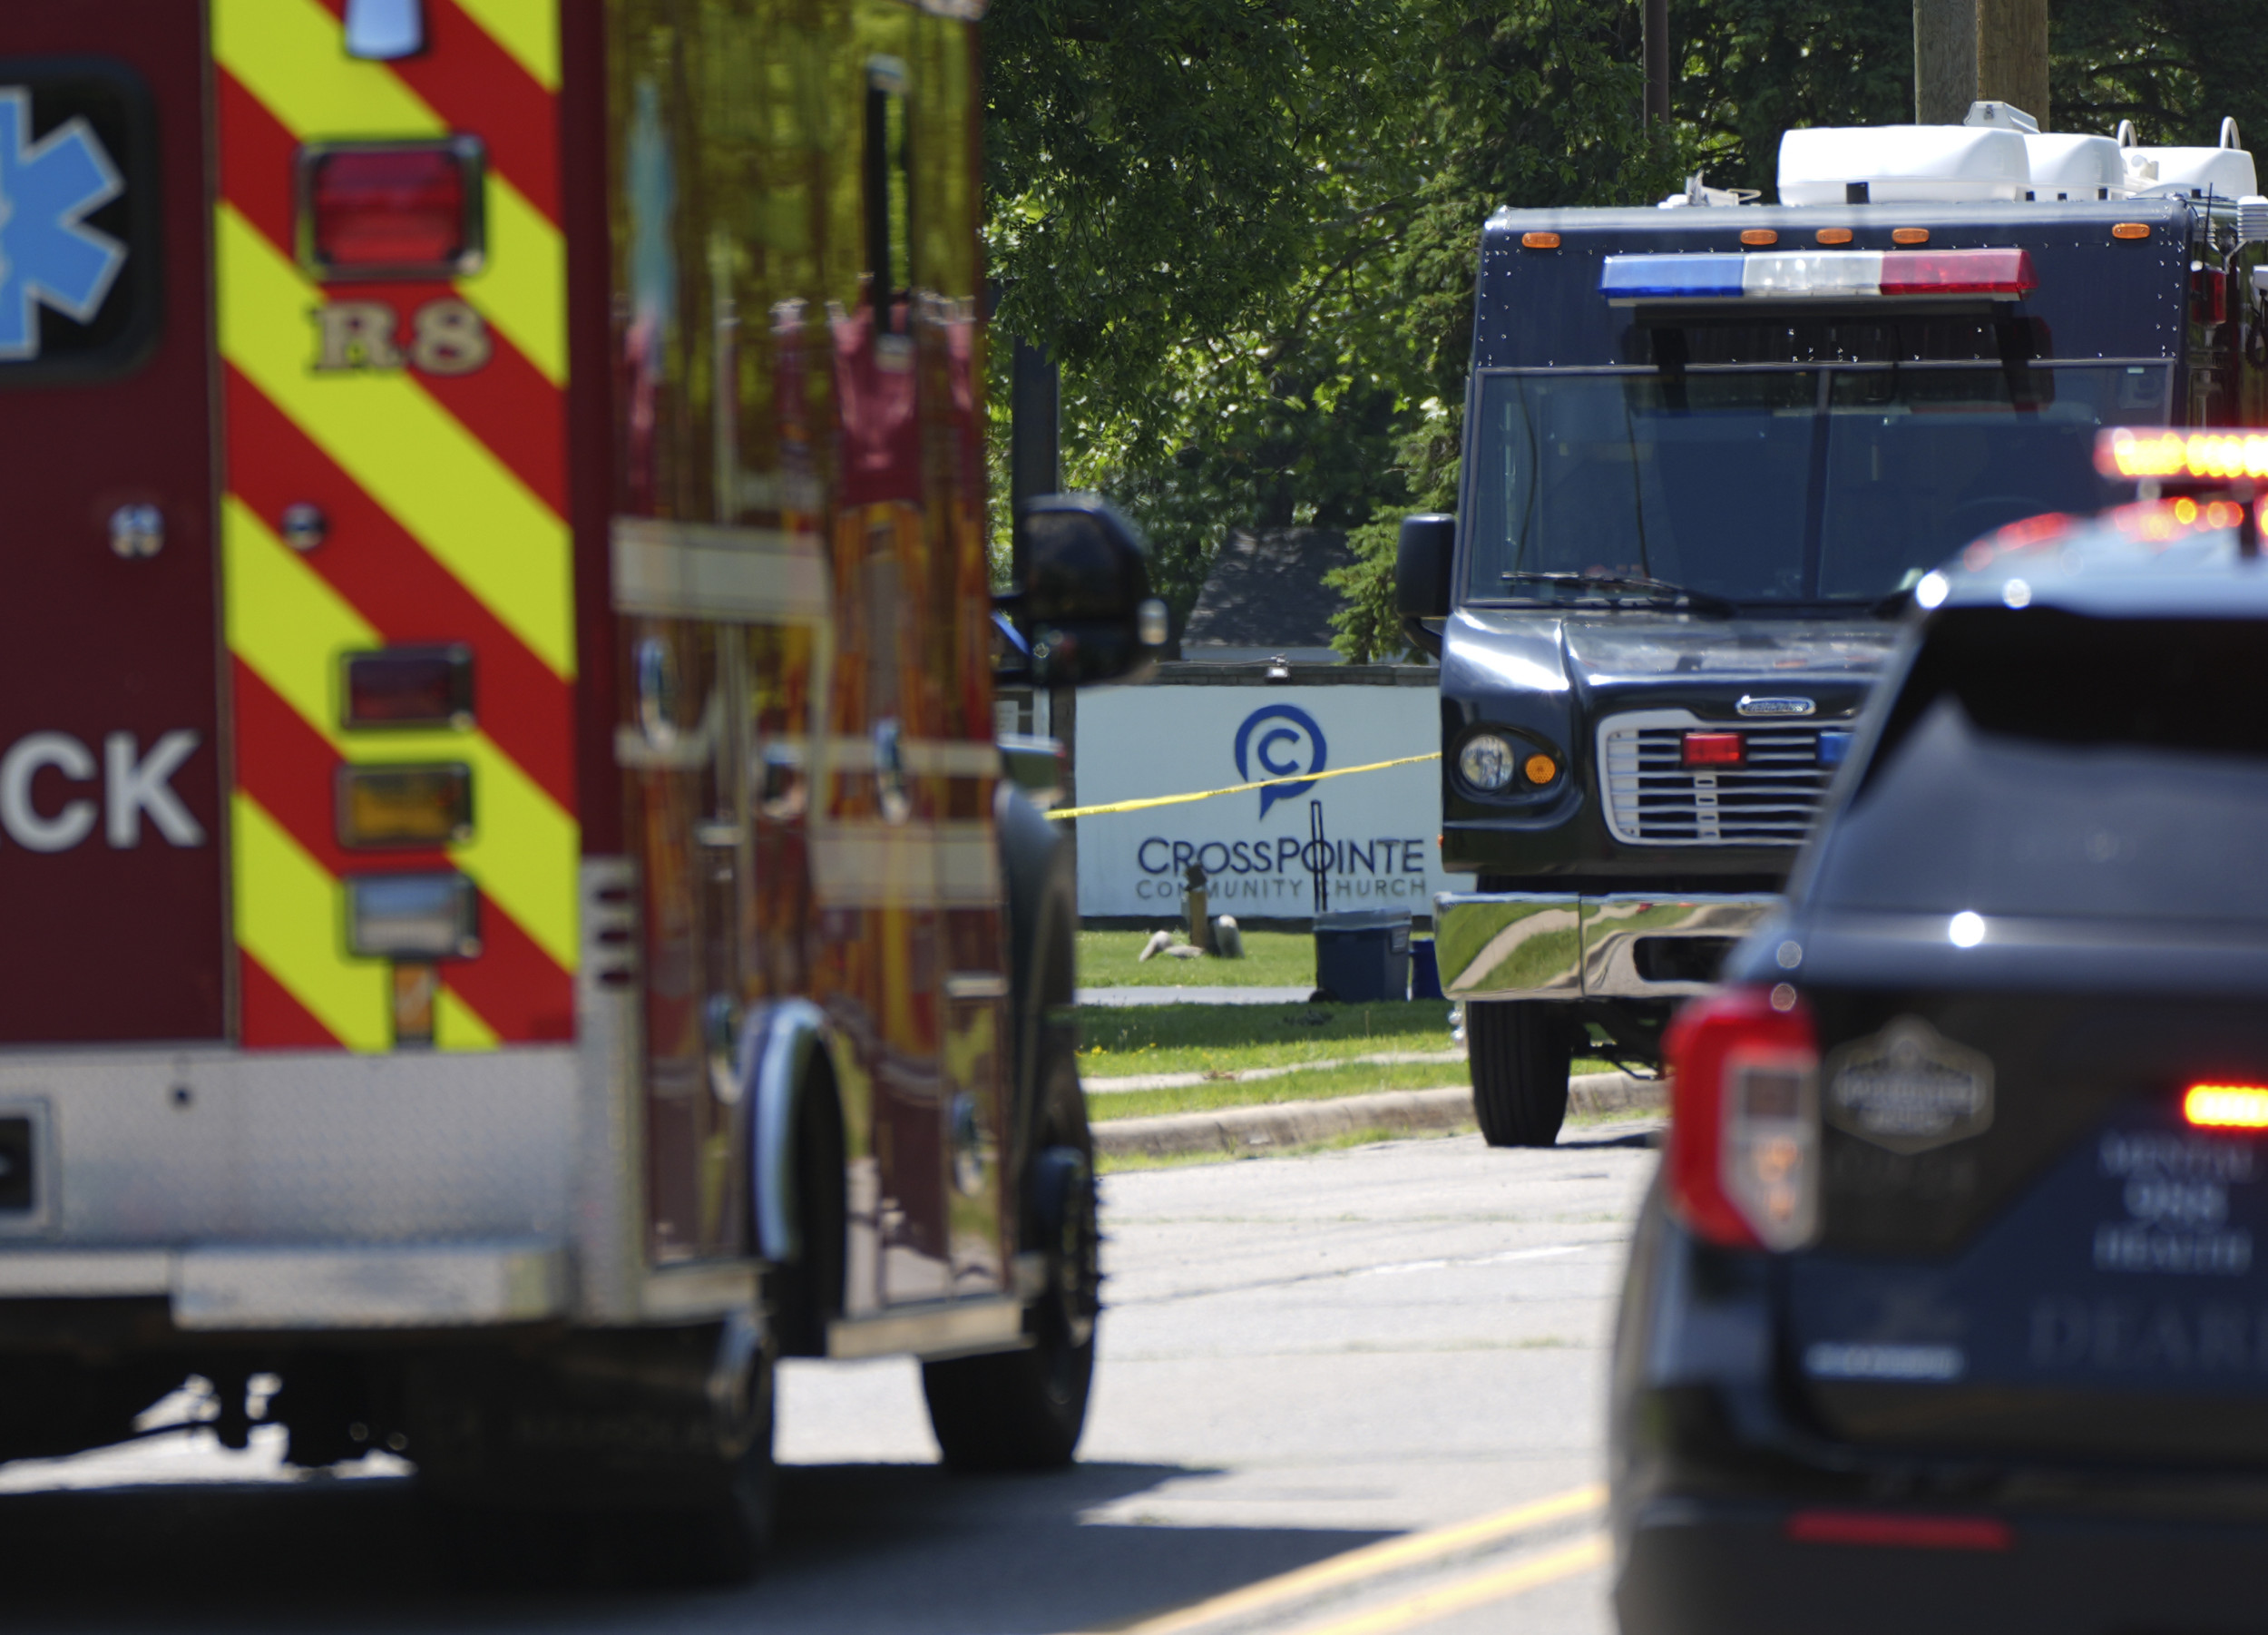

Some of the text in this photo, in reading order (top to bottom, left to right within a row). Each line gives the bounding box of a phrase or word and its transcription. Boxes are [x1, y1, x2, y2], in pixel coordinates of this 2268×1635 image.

[304, 298, 494, 377] R8
[0, 729, 207, 852] CK
[1138, 837, 1424, 876] CROSSPOINTE
